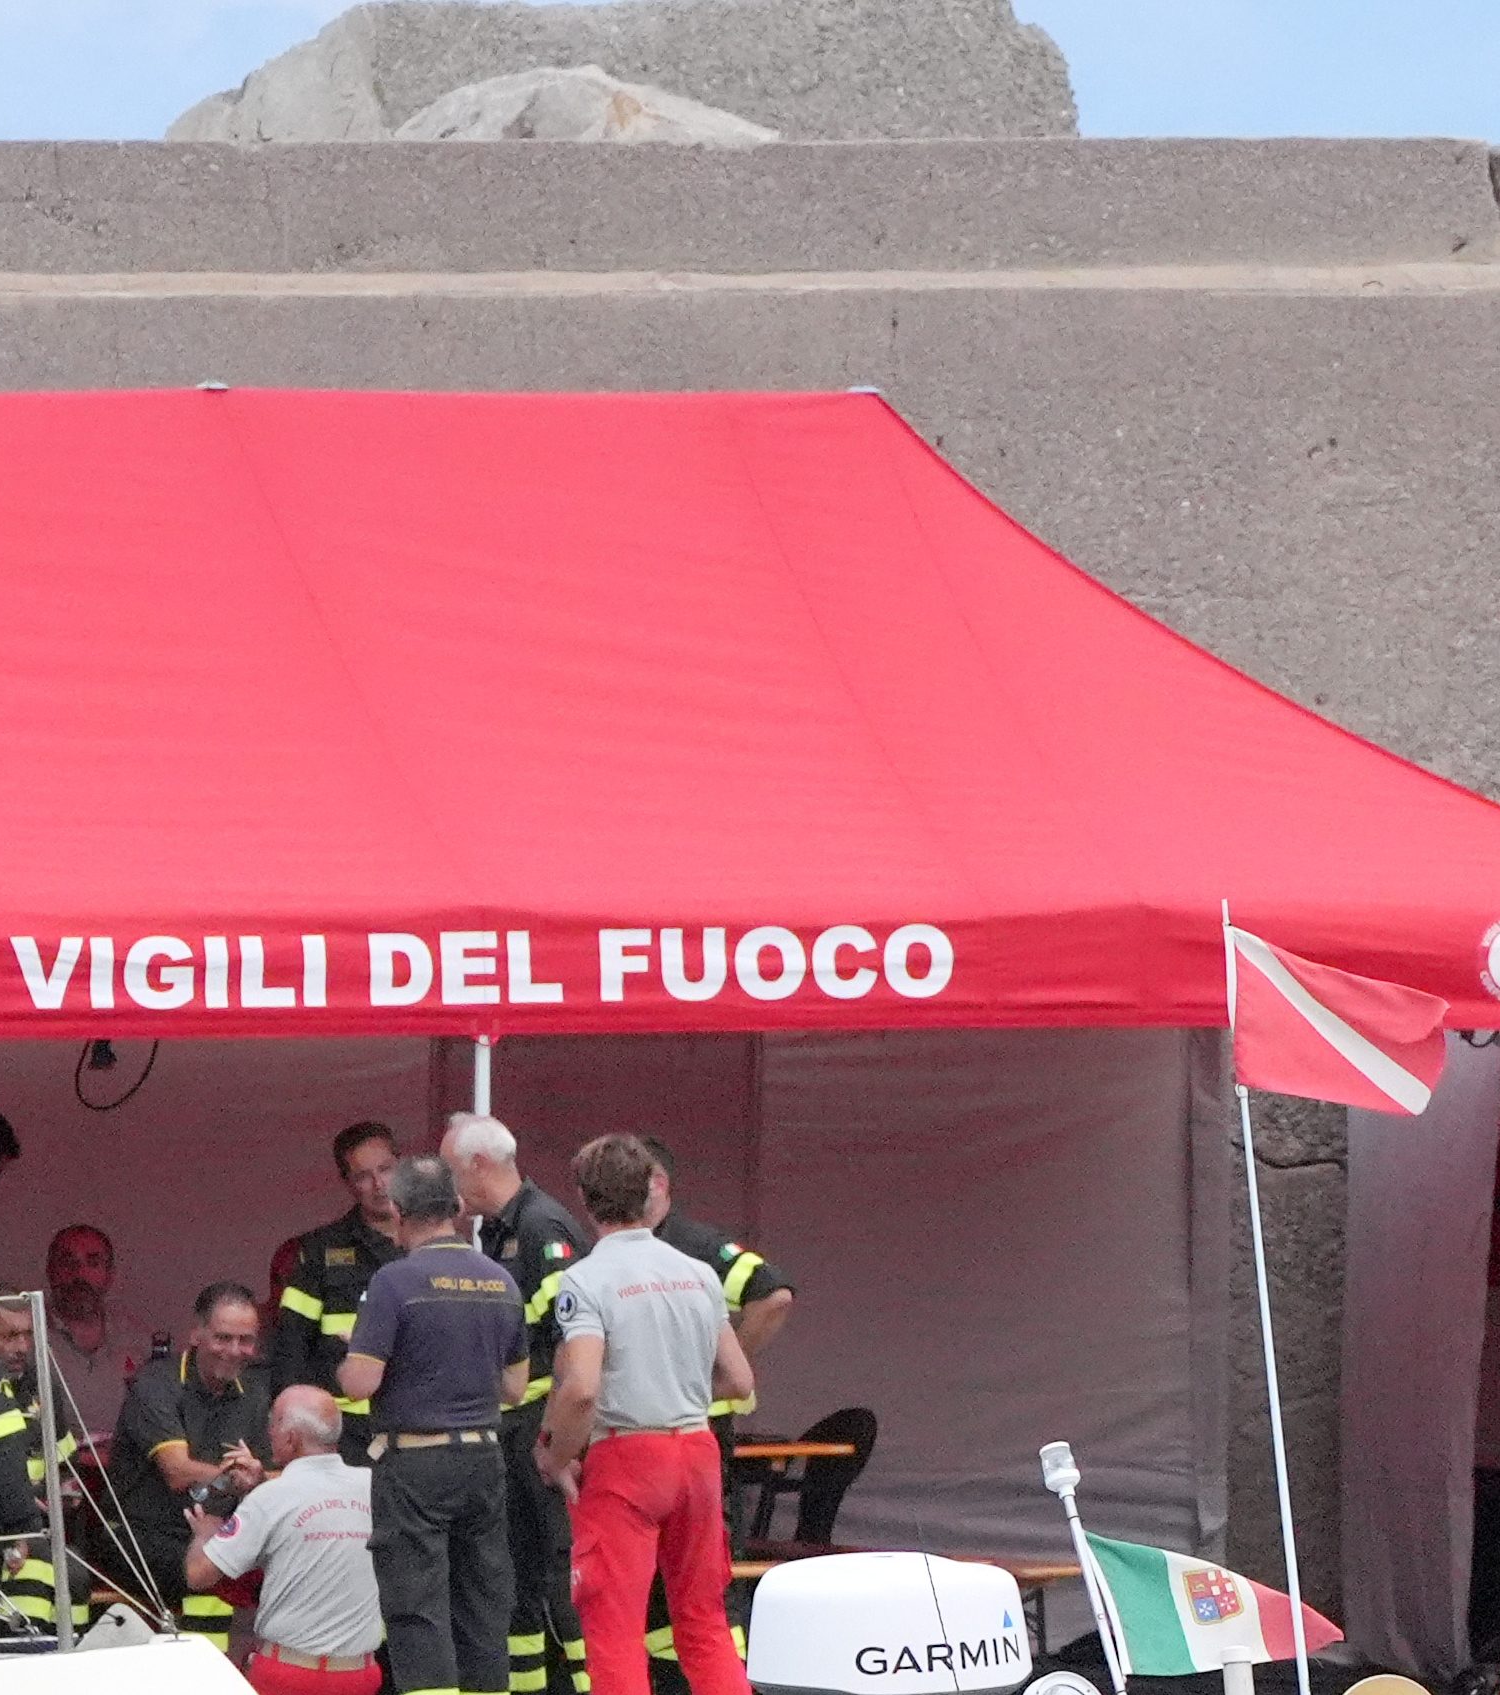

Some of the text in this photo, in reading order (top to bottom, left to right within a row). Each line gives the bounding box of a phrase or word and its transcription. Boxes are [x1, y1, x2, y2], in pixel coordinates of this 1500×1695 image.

[10, 923, 955, 1010] VIGILI DEL FUOCO
[854, 1633, 1021, 1677] GARMIN
